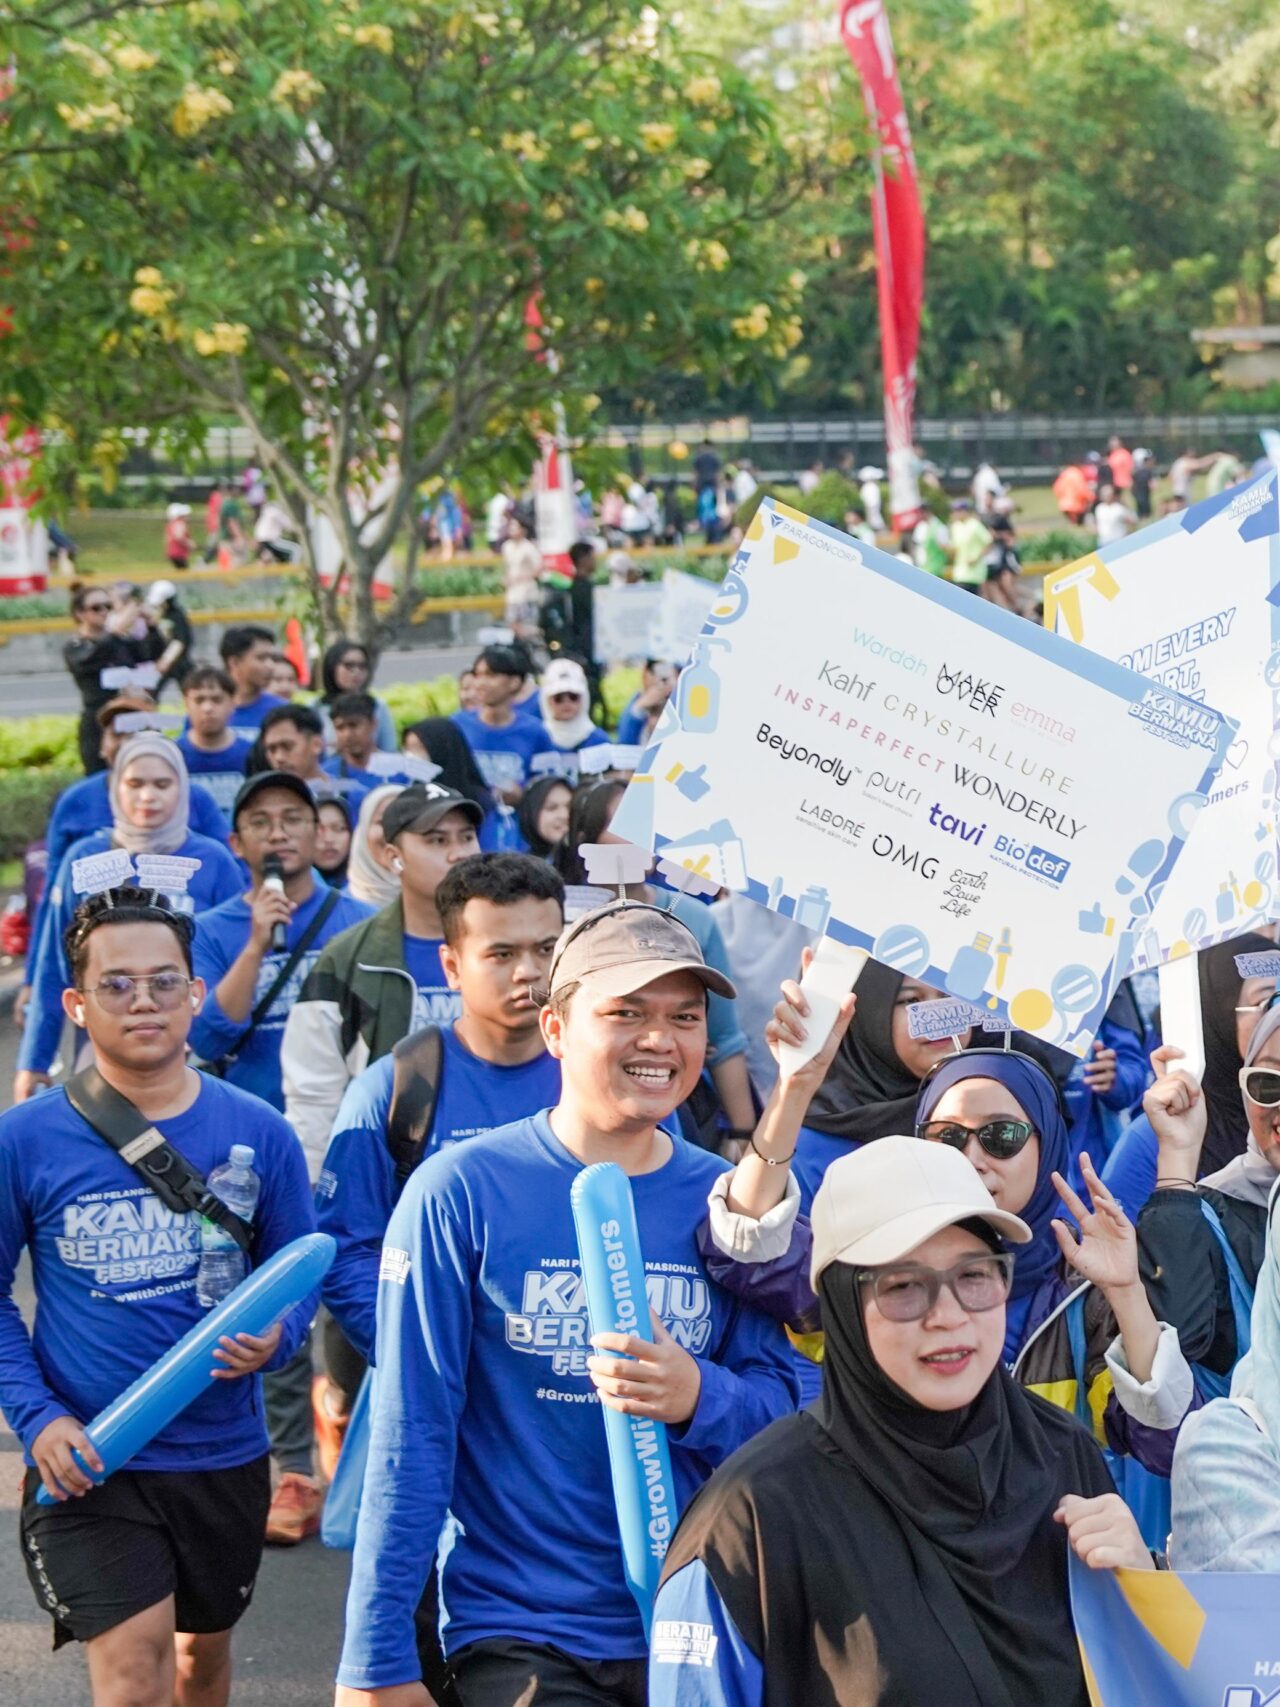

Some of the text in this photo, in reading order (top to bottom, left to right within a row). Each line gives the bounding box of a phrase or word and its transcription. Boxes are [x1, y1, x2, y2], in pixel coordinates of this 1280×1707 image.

[782, 522, 858, 563] PARAGONCORP
[1155, 606, 1237, 667] EVERY
[853, 627, 928, 677] Wardah
[1010, 702, 1077, 743] emina
[818, 660, 877, 701] Kahf
[884, 694, 1075, 794] CRYSTALLURE
[1128, 702, 1218, 753] BERMAKNA
[1140, 689, 1220, 735] KAMU
[774, 684, 1087, 840] INSTAPERFECT WONDERLY
[799, 799, 866, 839] LABORÉ
[866, 771, 922, 806] putri
[928, 803, 987, 846] tavi
[795, 815, 859, 849] sensitive skin care
[949, 868, 989, 891] Earth
[989, 853, 1018, 872] NATURAL
[940, 899, 972, 919] Life
[943, 884, 982, 904] Love
[910, 1017, 970, 1035] BERMAKN
[911, 1004, 973, 1027] KAMU
[77, 1193, 102, 1202] HARI
[57, 1228, 201, 1264] BERMAK
[96, 1260, 150, 1284] FEST
[541, 1258, 571, 1268] HARI
[645, 1261, 699, 1275] NASIONAL
